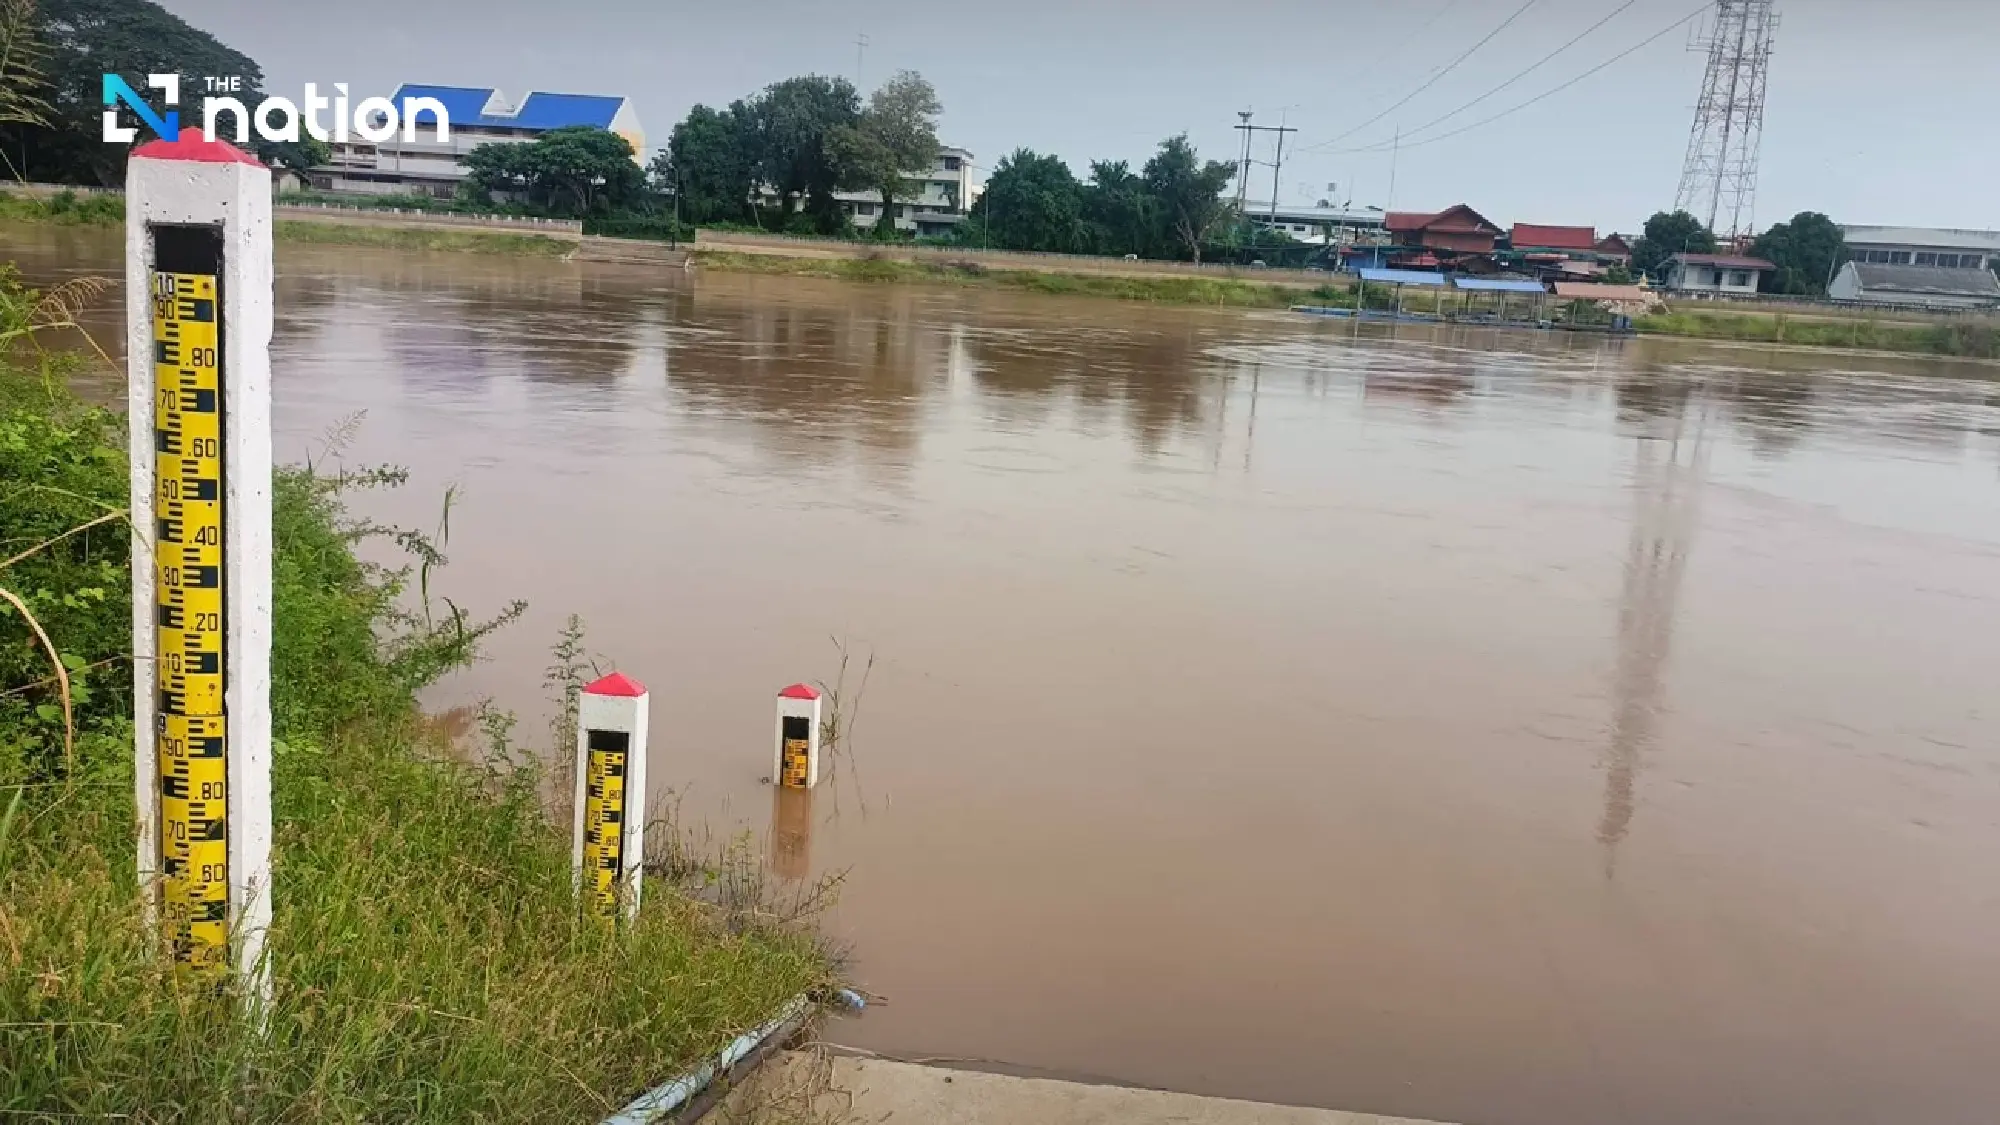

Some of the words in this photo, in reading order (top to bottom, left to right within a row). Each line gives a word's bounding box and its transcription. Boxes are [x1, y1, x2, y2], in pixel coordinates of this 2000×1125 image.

[185, 347, 215, 367] .80
[187, 438, 216, 458] .60
[189, 525, 218, 546] .40
[190, 612, 218, 632] .20
[195, 781, 224, 801] .80
